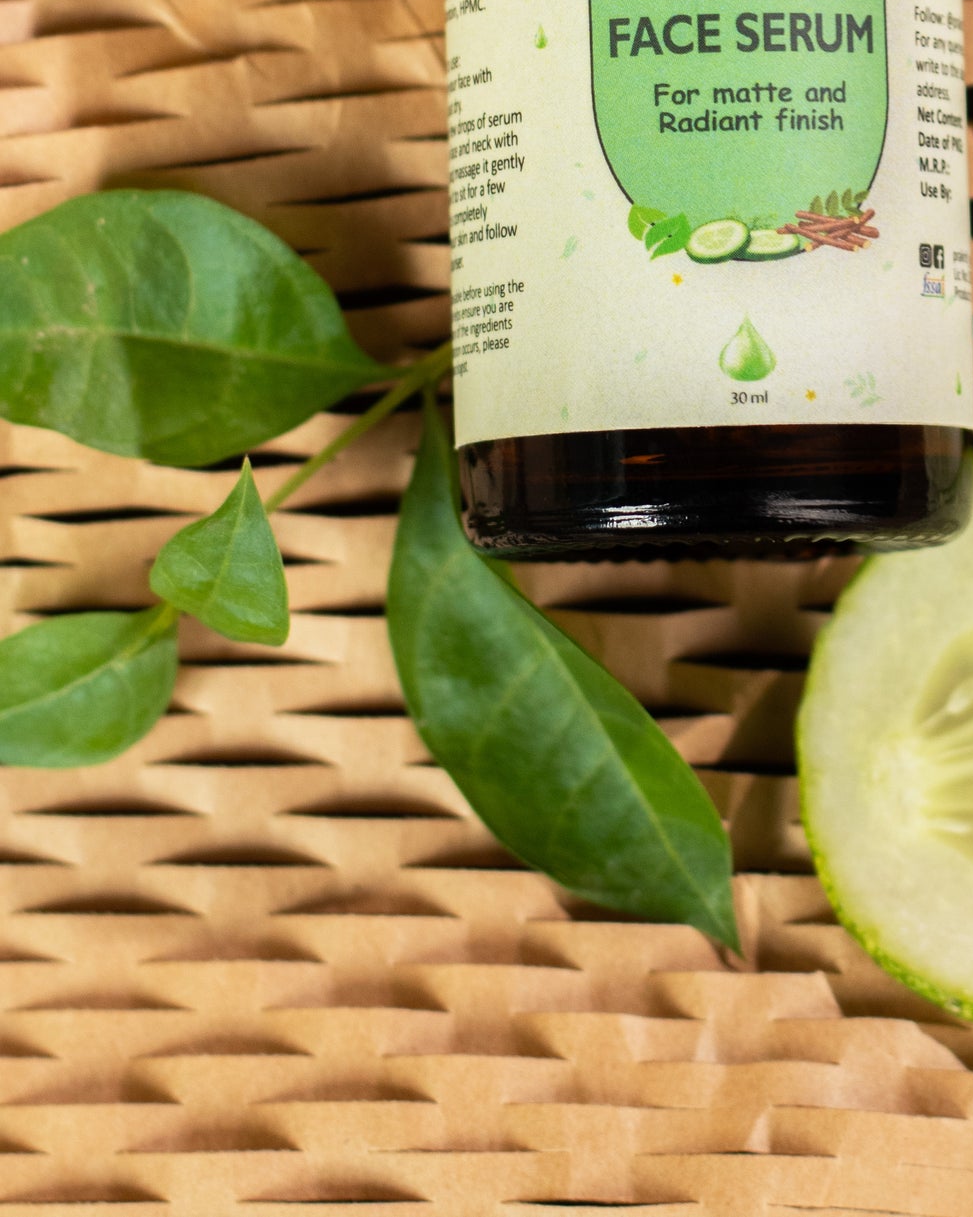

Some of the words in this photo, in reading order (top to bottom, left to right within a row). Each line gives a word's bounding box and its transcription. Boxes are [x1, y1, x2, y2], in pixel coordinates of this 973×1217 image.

[608, 13, 722, 58] FACE
[735, 12, 874, 54] SERUM
[915, 30, 930, 48] For
[473, 66, 492, 85] with
[654, 83, 700, 107] For
[714, 82, 792, 104] matte
[805, 81, 847, 103] and
[477, 112, 486, 130] of
[488, 111, 522, 128] serum
[659, 109, 763, 134] Radiant
[775, 107, 844, 132] finish
[917, 106, 934, 123] Net
[459, 138, 470, 156] and
[472, 134, 491, 152] neck
[494, 130, 518, 148] with
[918, 131, 940, 149] Date
[483, 158, 489, 173] it
[491, 153, 525, 176] gently
[468, 183, 477, 199] for
[479, 185, 485, 196] a
[487, 179, 505, 195] few
[921, 181, 938, 198] Use
[469, 226, 484, 243] and
[486, 223, 518, 241] follow
[463, 285, 482, 301] before
[484, 283, 506, 298] using
[508, 279, 525, 294] the
[482, 303, 497, 317] you
[498, 301, 514, 313] are
[470, 318, 513, 338] ingredients
[483, 337, 510, 353] please
[730, 391, 748, 405] 30
[751, 390, 768, 404] ml
